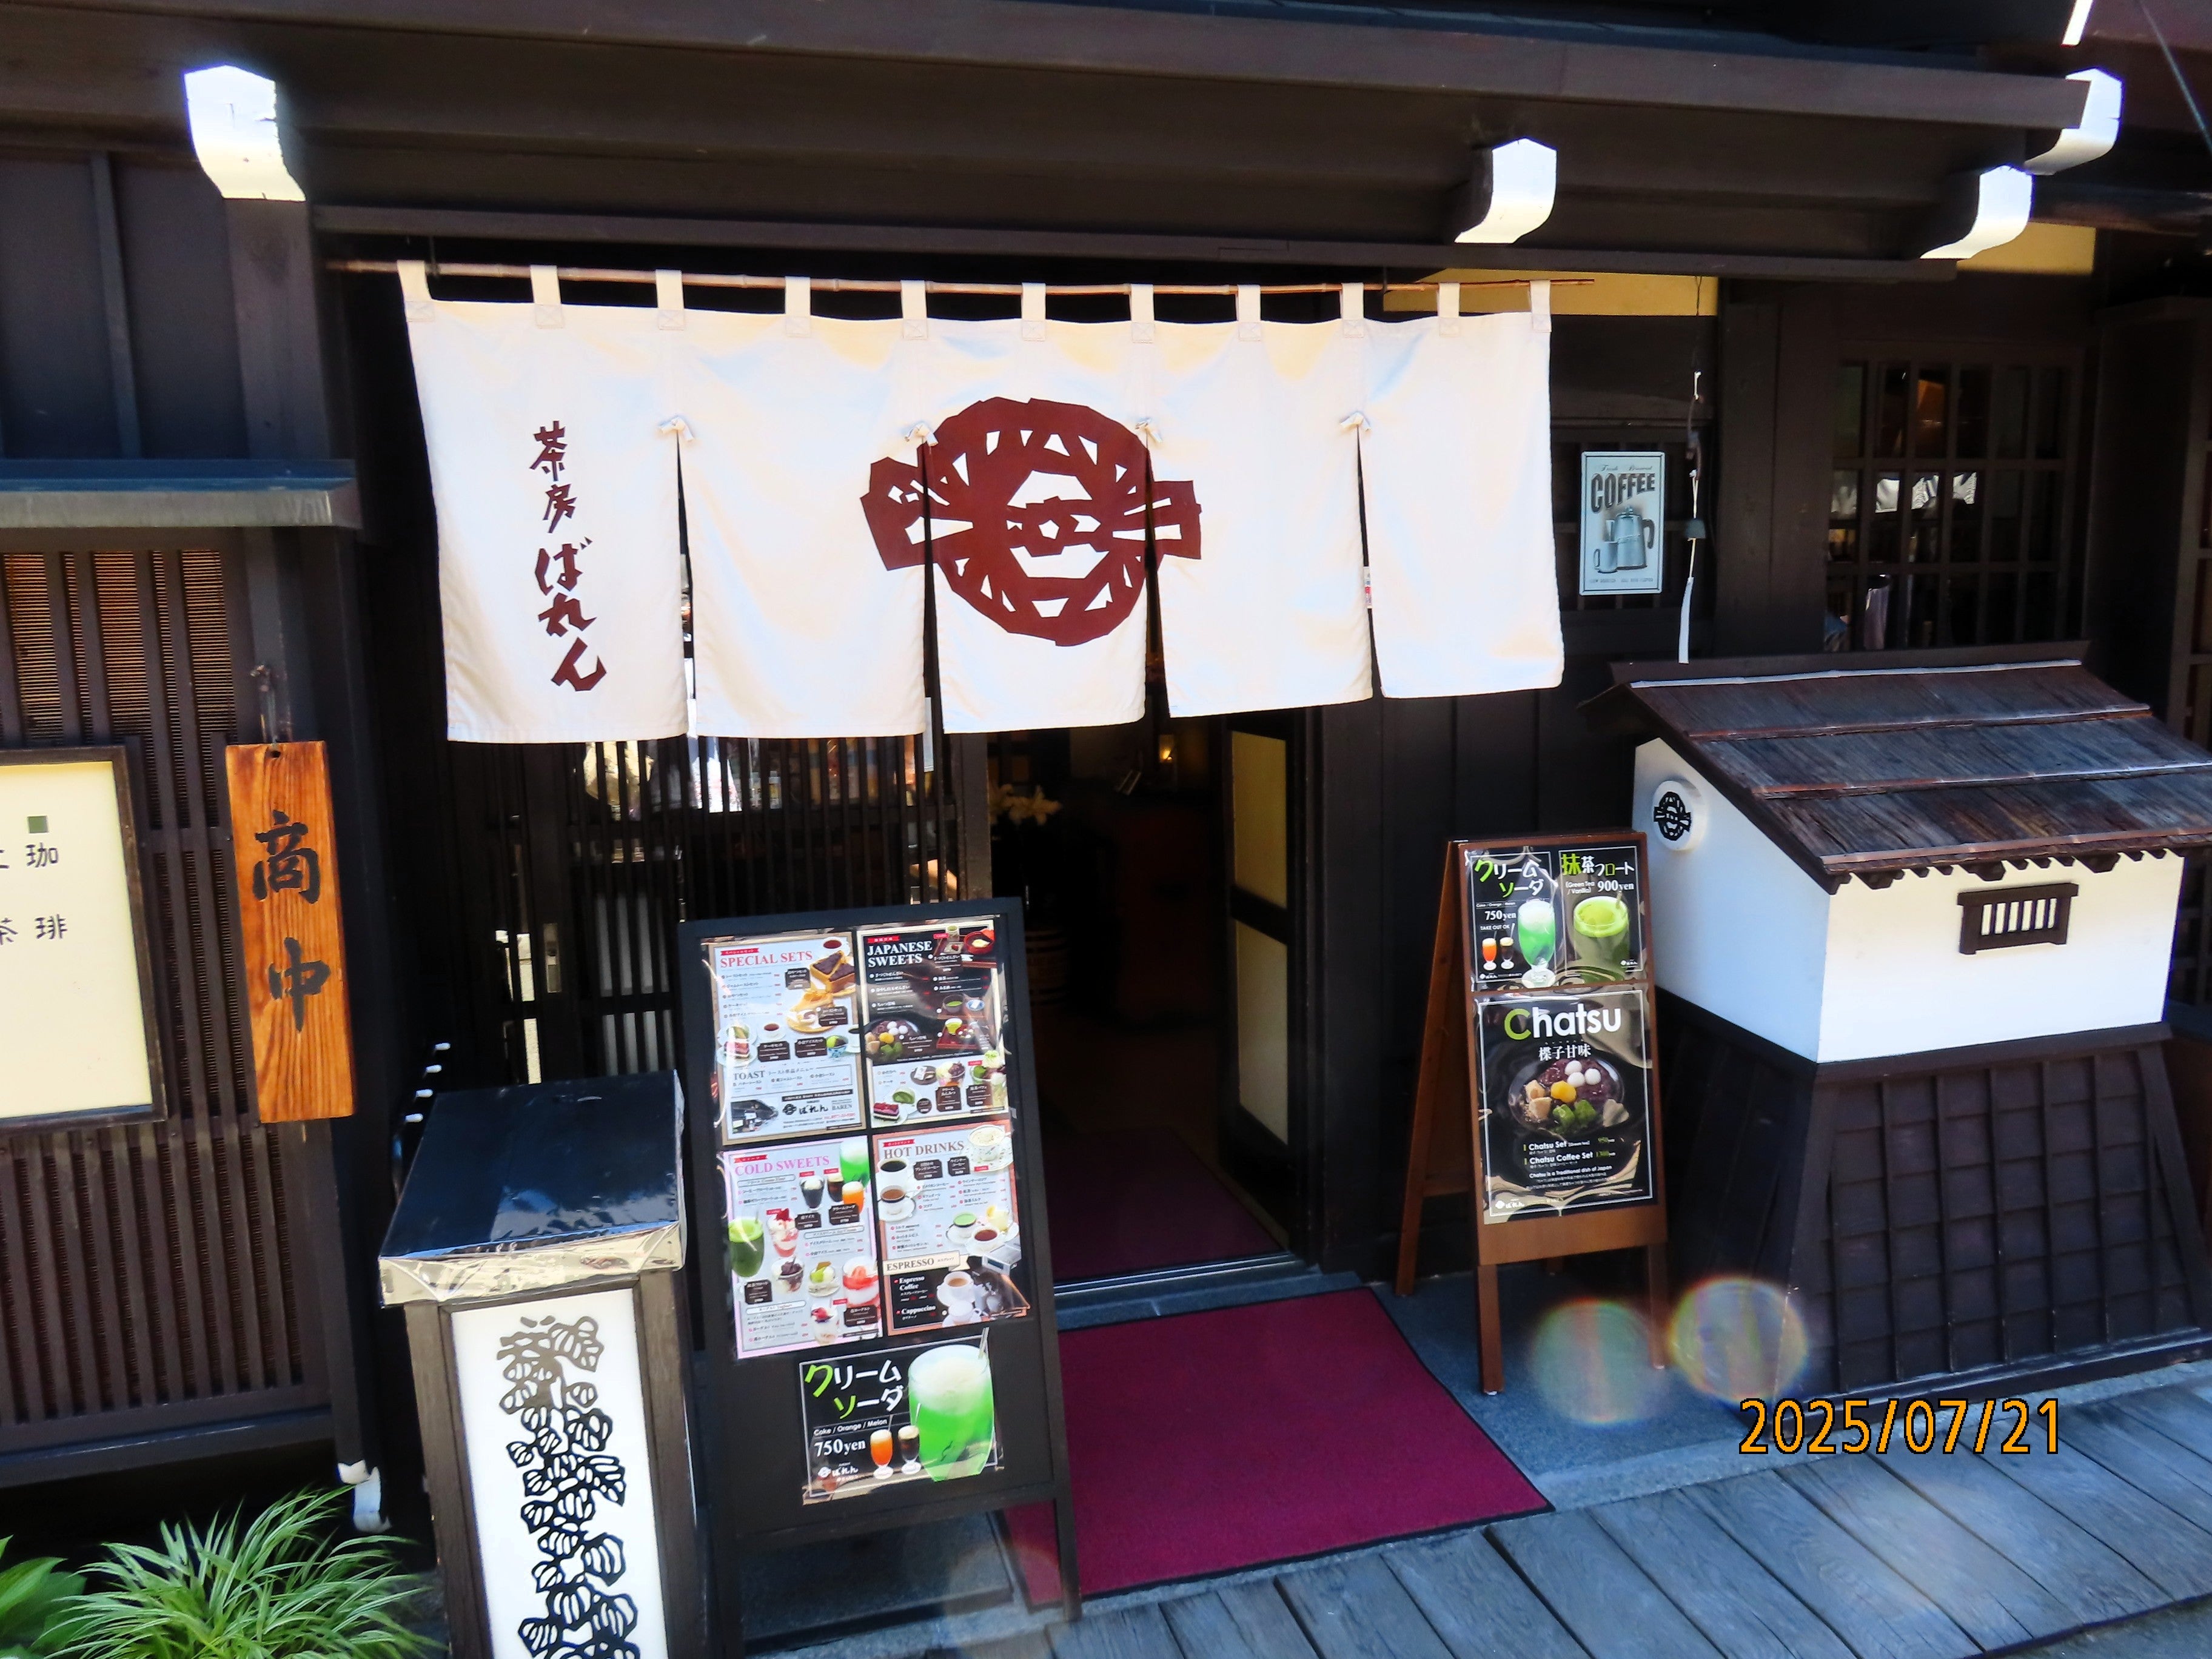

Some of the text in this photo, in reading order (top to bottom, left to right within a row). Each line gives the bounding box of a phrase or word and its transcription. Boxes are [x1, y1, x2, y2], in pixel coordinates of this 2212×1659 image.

[1591, 473, 1655, 514] COFFEE
[1474, 859, 1540, 882] クリーム
[1561, 853, 1635, 877] 抹茶フロート
[25, 842, 68, 940] 珈琲
[1499, 879, 1544, 898] ソーダ
[1484, 910, 1517, 921] 750yen
[866, 940, 933, 956] JAPANESE
[720, 951, 813, 968] SPECIAL SETS
[868, 953, 923, 968] SWEETS
[1504, 1003, 1621, 1040] Chatsu
[733, 1070, 766, 1081] TOAST
[883, 1141, 965, 1159] HOT DRINKS
[1529, 1142, 1554, 1151] Chatsu
[735, 1162, 773, 1176] COLD
[776, 1155, 830, 1171] SWEETS
[1556, 1153, 1581, 1162] Coffee
[886, 1258, 934, 1272] ESPRESSO
[900, 1304, 937, 1315] Cappuccino
[805, 1359, 902, 1398] クリーム
[834, 1385, 904, 1419] ソーダ
[813, 1428, 832, 1436] Coke
[837, 1423, 862, 1432] Orange
[867, 1419, 887, 1427] Melon
[814, 1438, 866, 1457] 750yen
